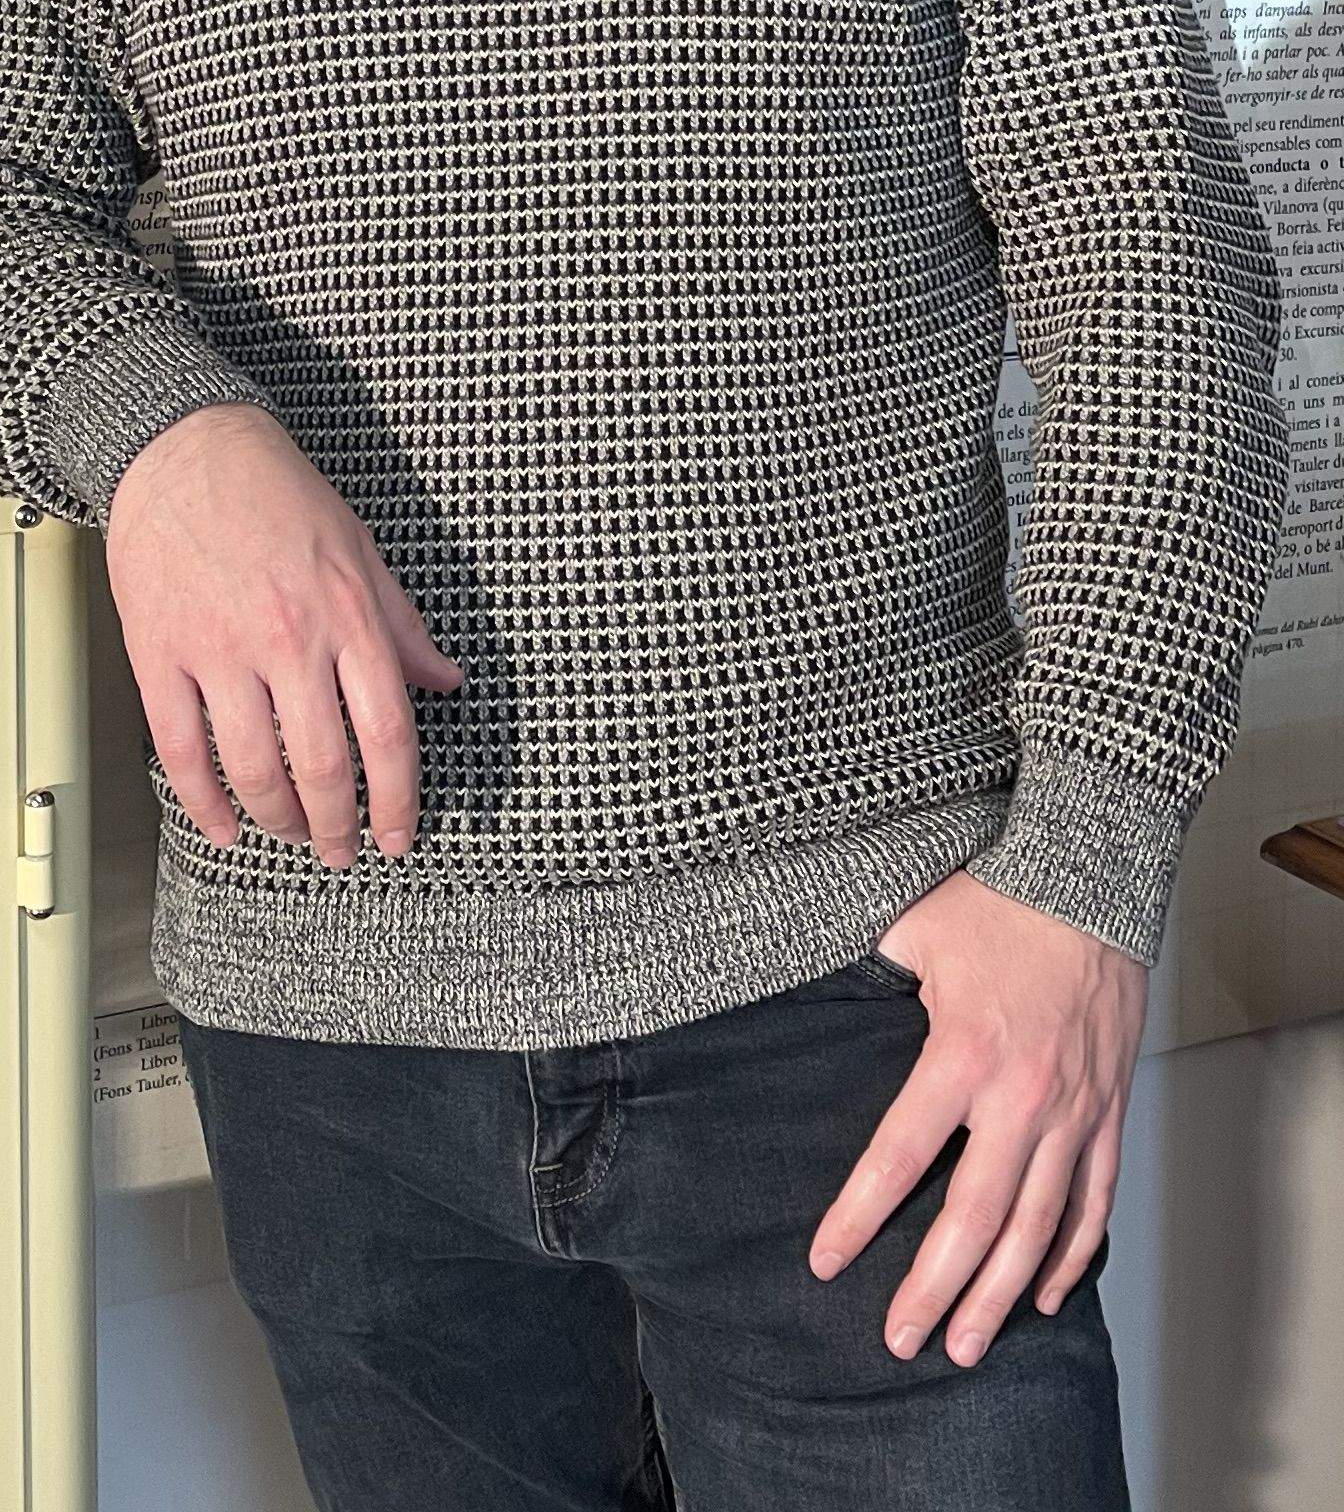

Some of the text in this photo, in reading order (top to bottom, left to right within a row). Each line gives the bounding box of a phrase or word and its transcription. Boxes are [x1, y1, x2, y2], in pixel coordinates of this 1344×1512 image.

[141, 1054, 178, 1071] Libro
[93, 1074, 181, 1103] (Fons Tauler,
